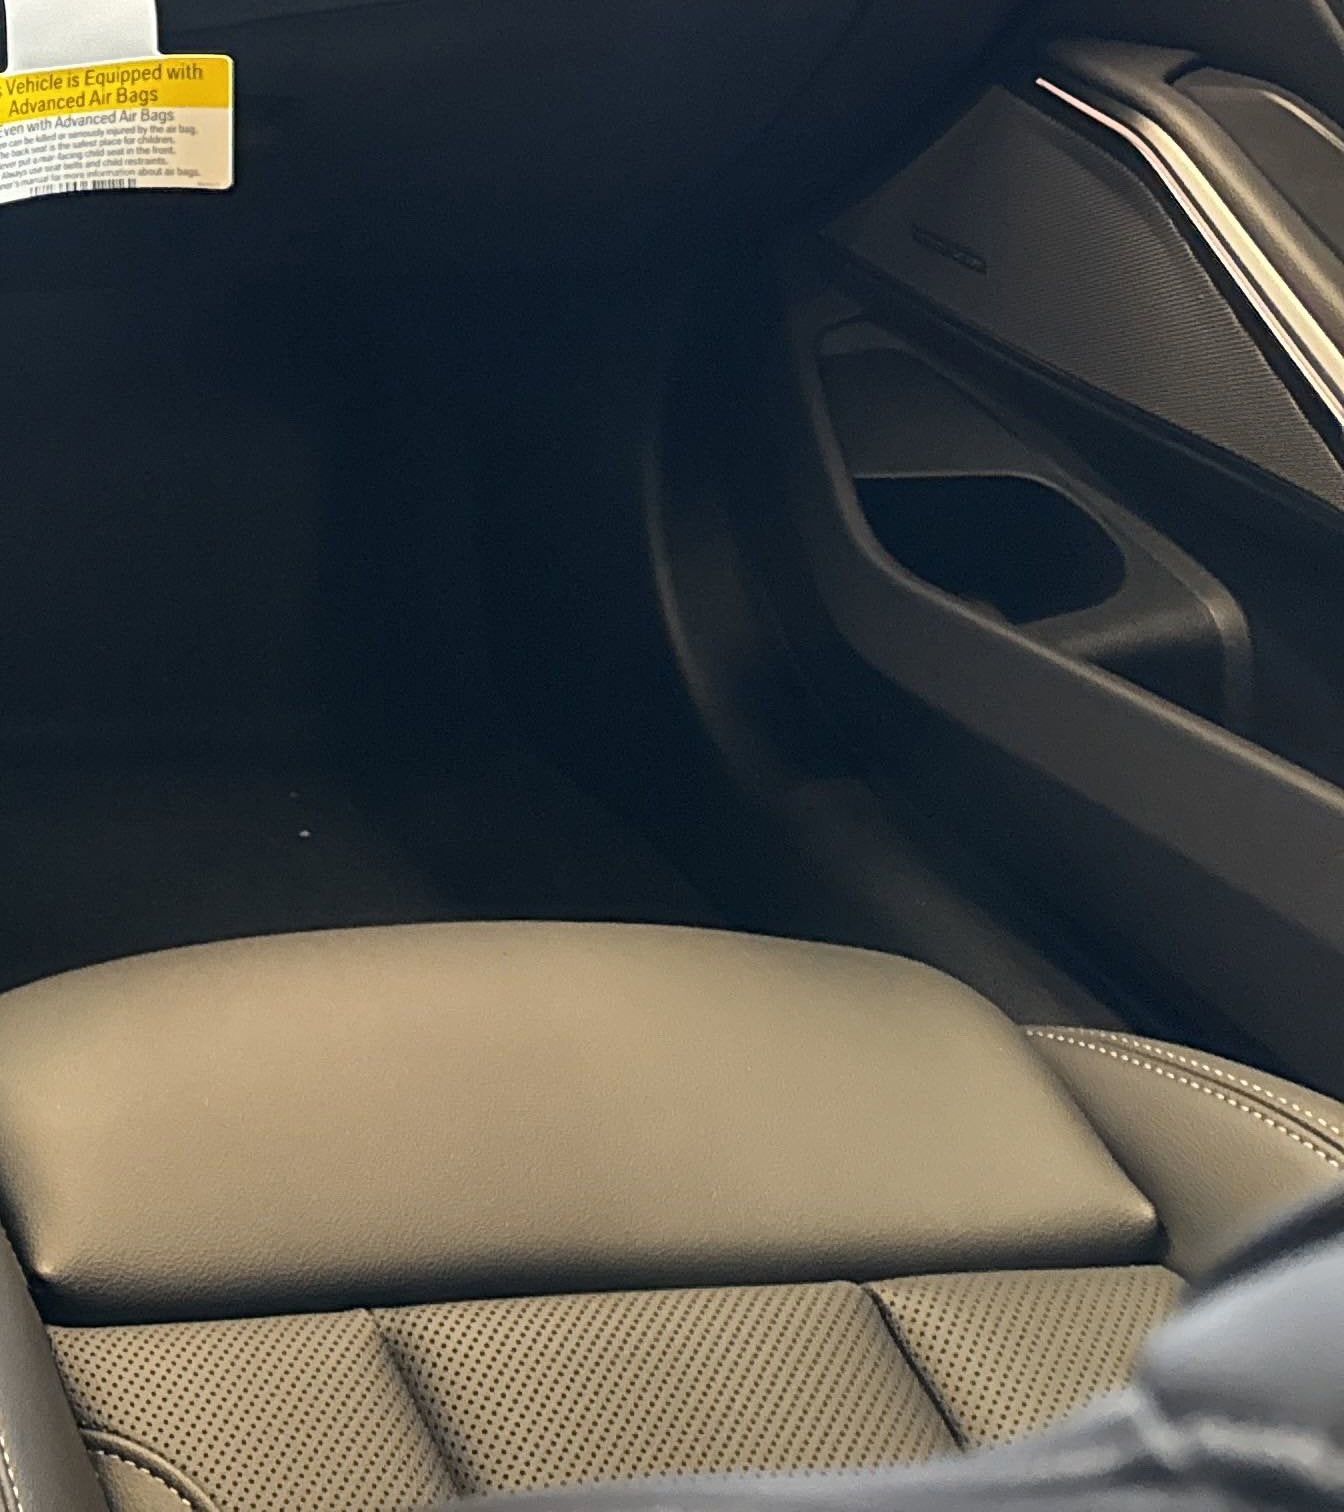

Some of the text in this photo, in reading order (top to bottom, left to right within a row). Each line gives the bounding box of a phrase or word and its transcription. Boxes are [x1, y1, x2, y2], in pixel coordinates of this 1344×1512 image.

[5, 73, 63, 96] Vehicle
[67, 71, 80, 89] is
[84, 63, 163, 88] Equipped
[166, 62, 204, 81] with
[8, 86, 159, 117] Advanced Air Bags
[26, 118, 52, 134] with
[54, 110, 117, 130] Advanced
[118, 109, 138, 123] Air
[140, 108, 176, 125] Bags
